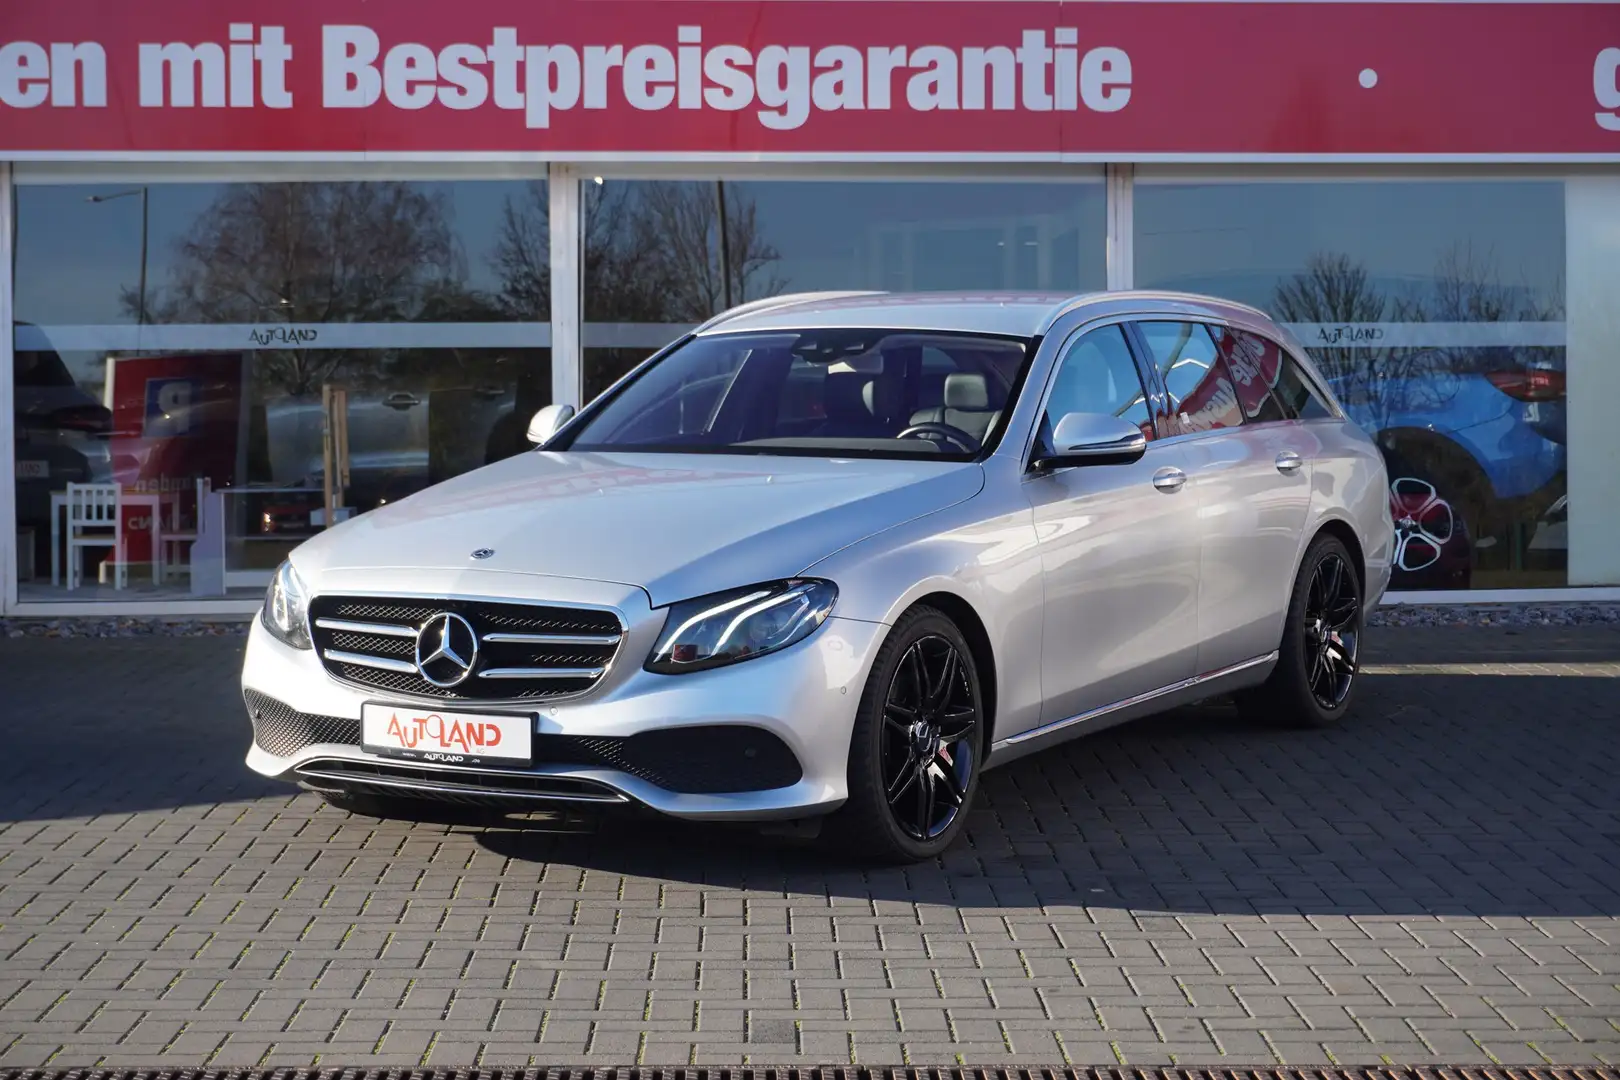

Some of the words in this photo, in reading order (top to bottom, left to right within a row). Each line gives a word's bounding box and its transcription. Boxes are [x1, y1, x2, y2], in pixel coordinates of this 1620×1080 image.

[138, 23, 293, 108] mit
[322, 24, 1132, 130] Bestpreisgarantie
[248, 326, 318, 346] AUTOLAND
[387, 712, 502, 753] AUTOLAND
[423, 752, 464, 763] AUTOLAND
